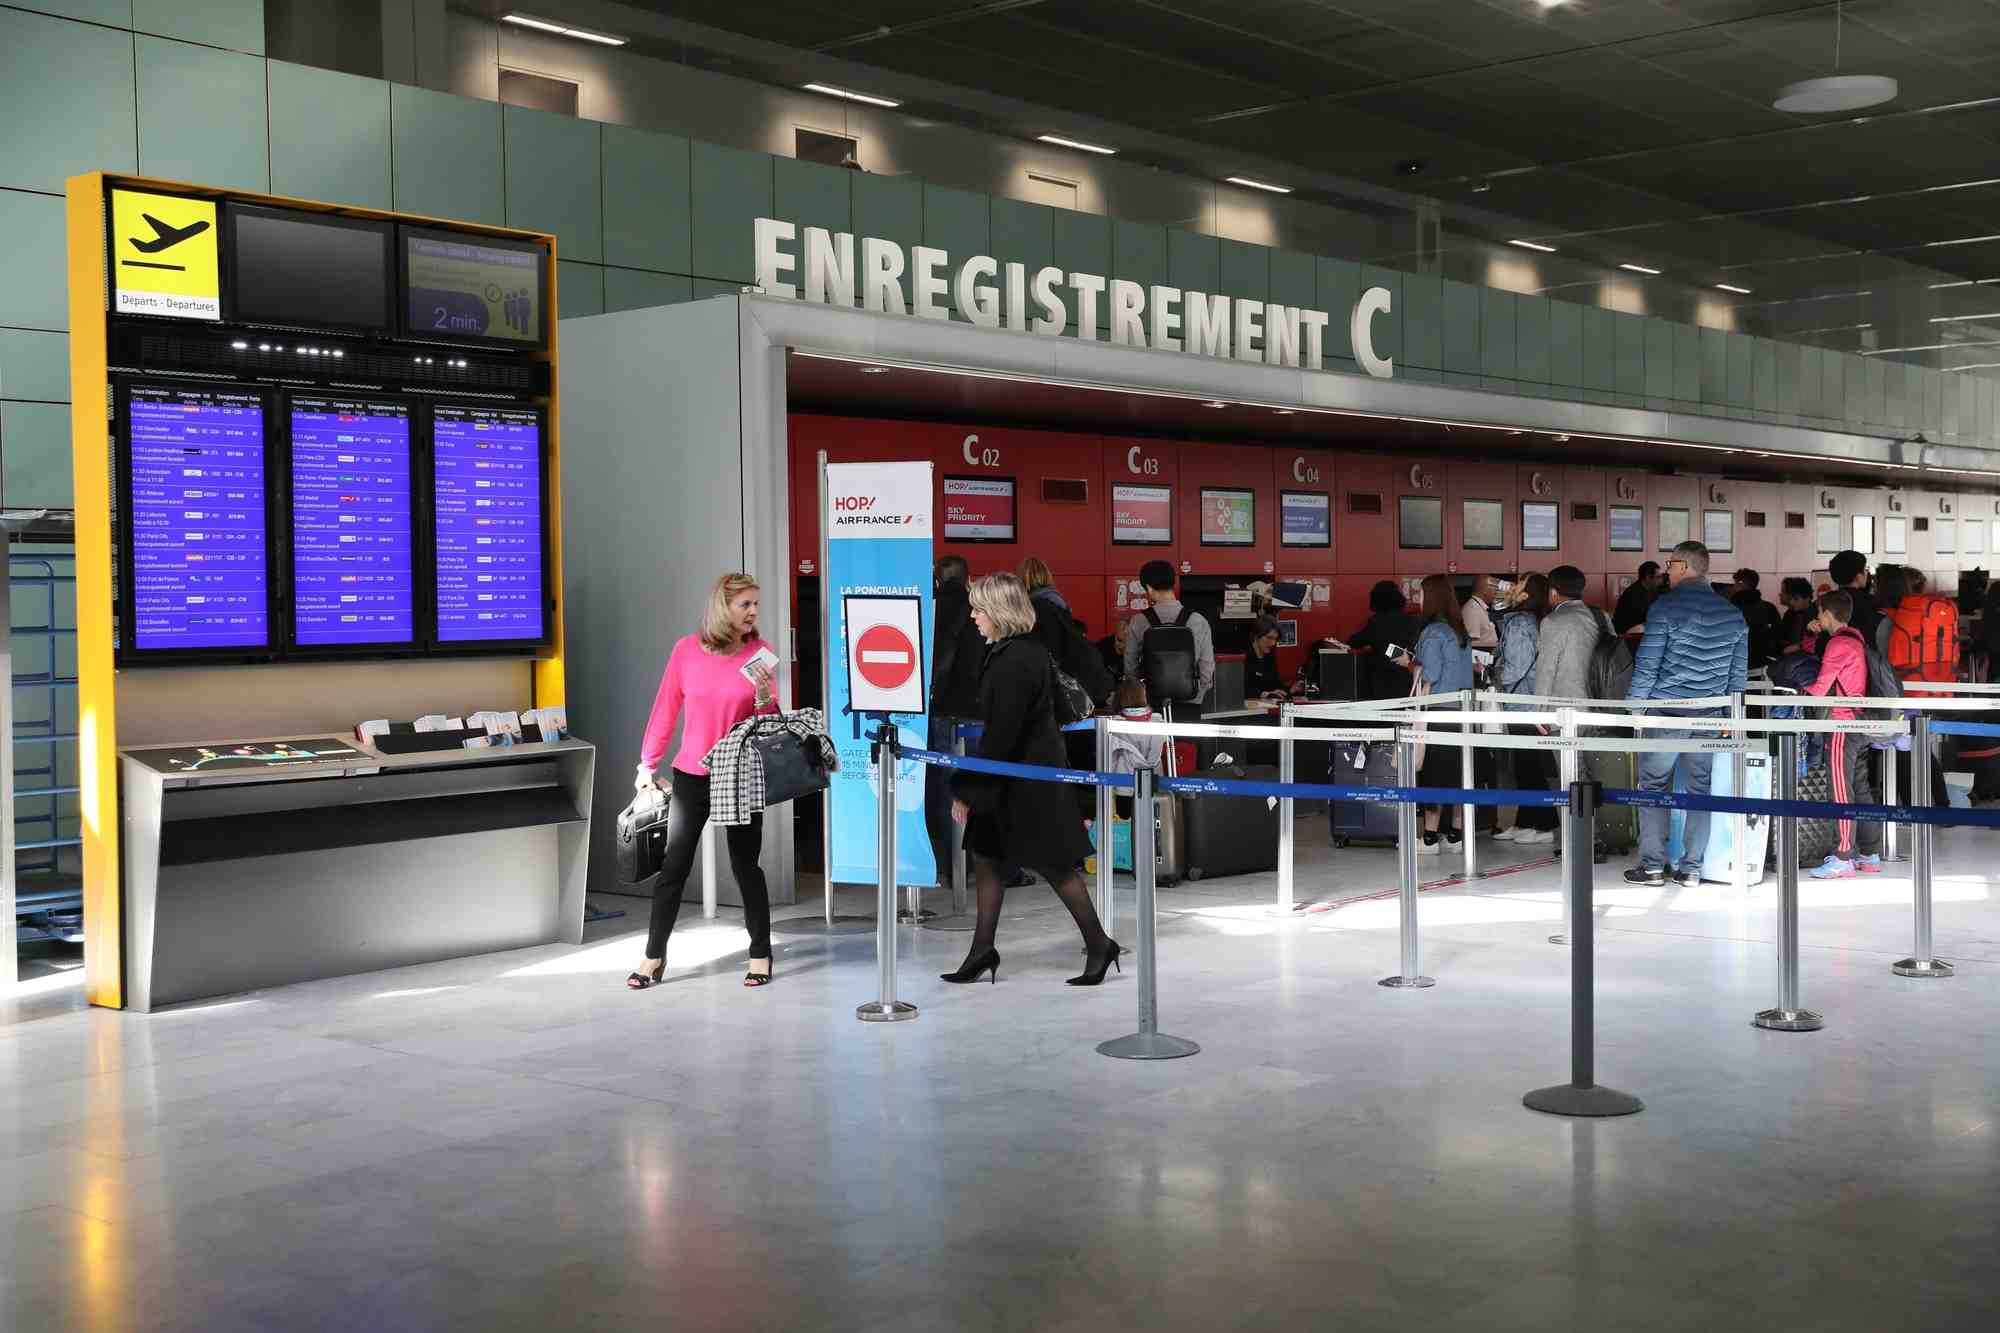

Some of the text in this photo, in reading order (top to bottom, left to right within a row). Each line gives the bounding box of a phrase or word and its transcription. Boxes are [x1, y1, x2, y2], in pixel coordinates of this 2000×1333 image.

[166, 298, 216, 312] Departures
[754, 217, 1393, 378] ENREGISTREMENT C
[433, 306, 448, 328] 2
[963, 434, 1000, 467] C 02
[1128, 446, 1159, 475] C 03
[1293, 456, 1320, 484] C 04
[1410, 464, 1421, 488] C
[835, 496, 876, 511] HOP!
[836, 515, 901, 525] AIRFRANCE
[948, 513, 986, 521] PRIORITY
[840, 585, 852, 594] LA
